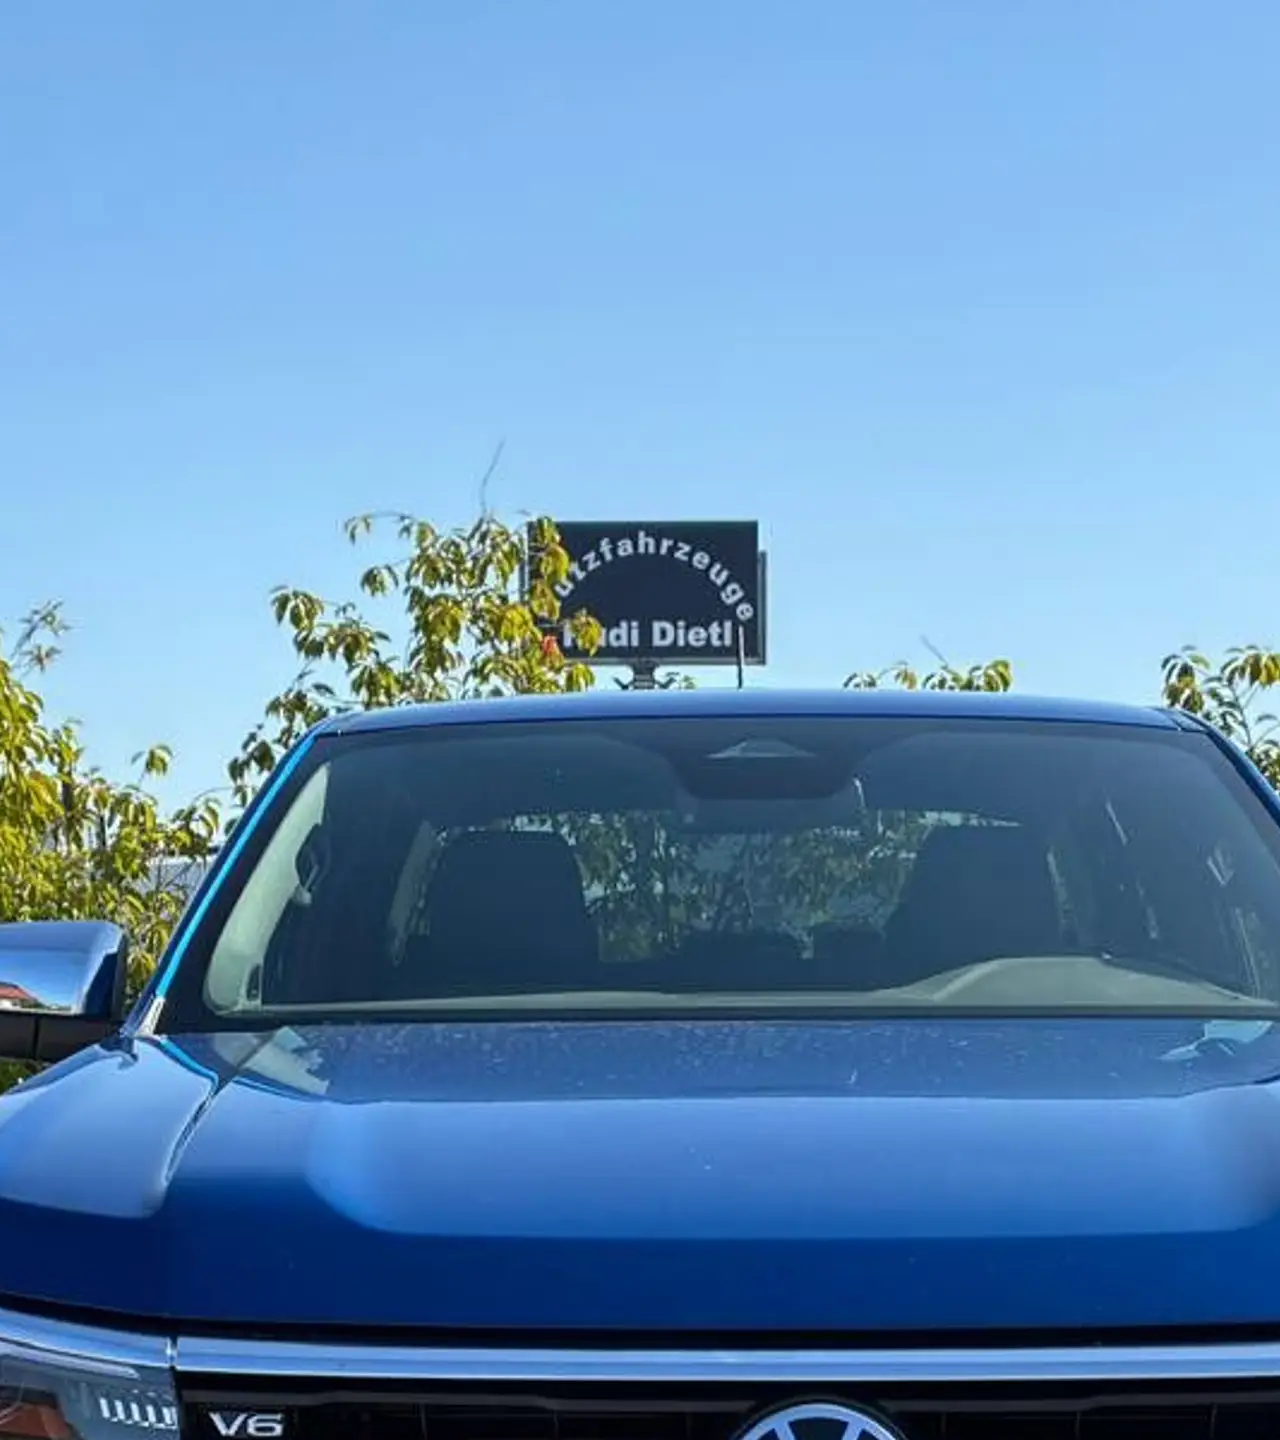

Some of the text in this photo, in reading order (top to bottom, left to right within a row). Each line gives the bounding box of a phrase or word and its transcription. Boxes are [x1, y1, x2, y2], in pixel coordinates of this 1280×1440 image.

[554, 530, 755, 620] utzfahrzeuge
[651, 619, 734, 648] Dietl
[208, 1411, 284, 1437] V6
